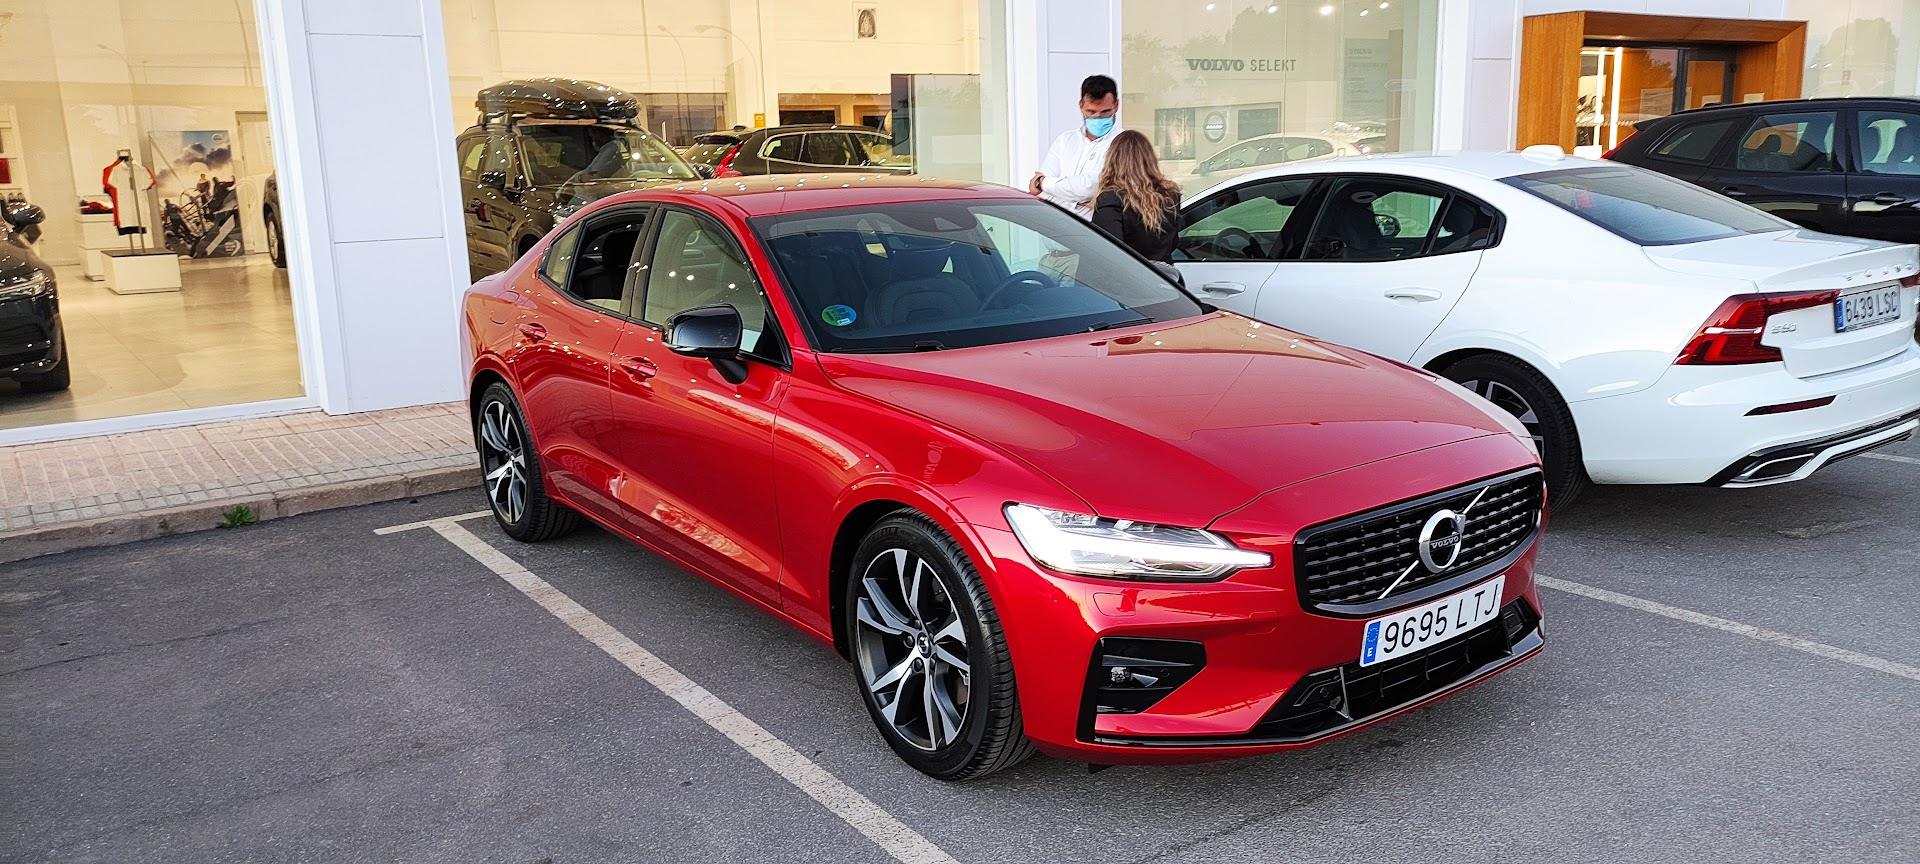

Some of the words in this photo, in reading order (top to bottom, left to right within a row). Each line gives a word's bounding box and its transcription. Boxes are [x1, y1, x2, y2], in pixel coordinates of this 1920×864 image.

[1185, 58, 1245, 71] VOLVO
[1250, 59, 1296, 71] SELEKT
[1846, 295, 1873, 322] 6439
[1876, 290, 1898, 316] LSC
[1430, 535, 1460, 549] VOLVO
[1383, 605, 1449, 653] 9695
[1456, 583, 1499, 629] LTJ
[1367, 647, 1373, 657] E
